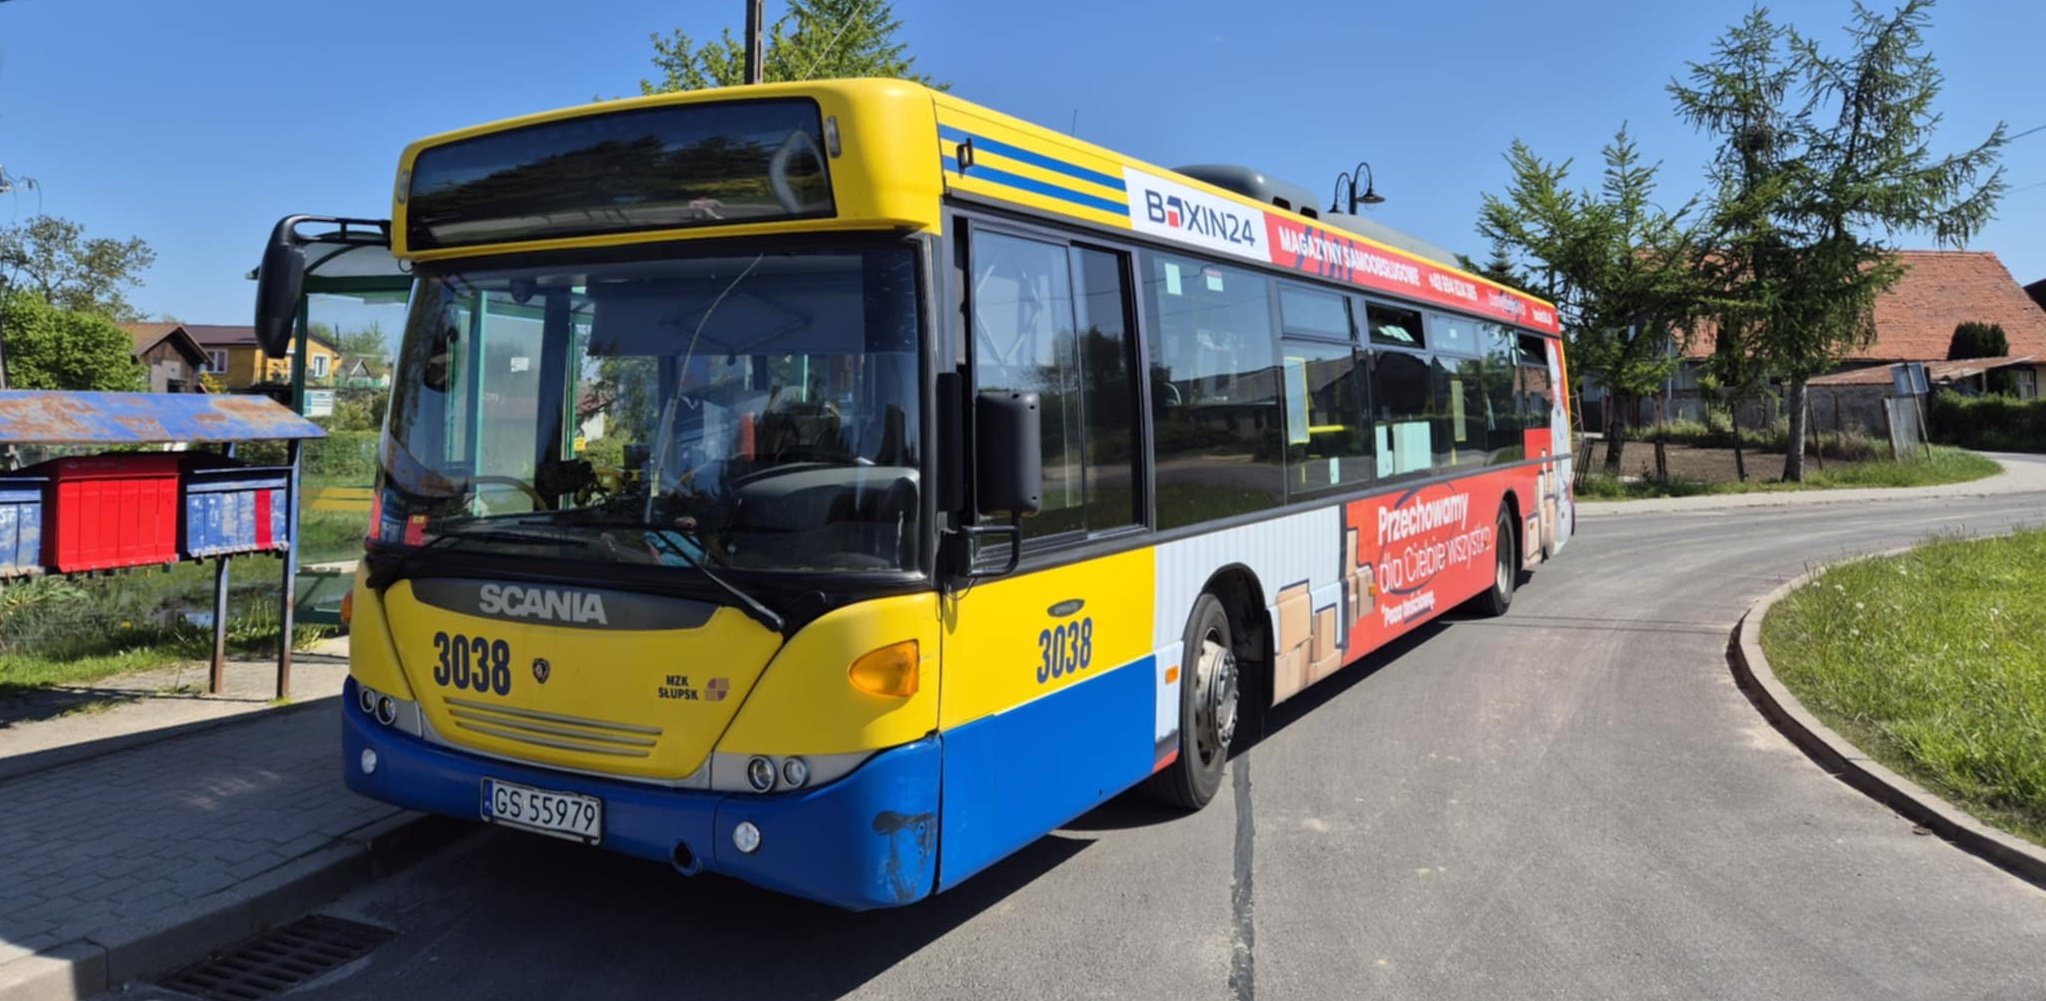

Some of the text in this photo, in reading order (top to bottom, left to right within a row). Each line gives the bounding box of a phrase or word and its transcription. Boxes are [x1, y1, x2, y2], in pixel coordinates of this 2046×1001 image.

[1278, 225, 1342, 266] MAGAZYNY
[1378, 493, 1469, 545] Przechowamy
[1379, 552, 1403, 594] dla
[1404, 535, 1445, 583] Ciebie
[479, 584, 608, 625] SCANIA
[434, 631, 511, 696] 3038
[1036, 617, 1093, 684] 3038
[658, 686, 699, 701] SŁUPSK
[666, 675, 688, 687] MZK
[495, 787, 596, 832] GS 55979
